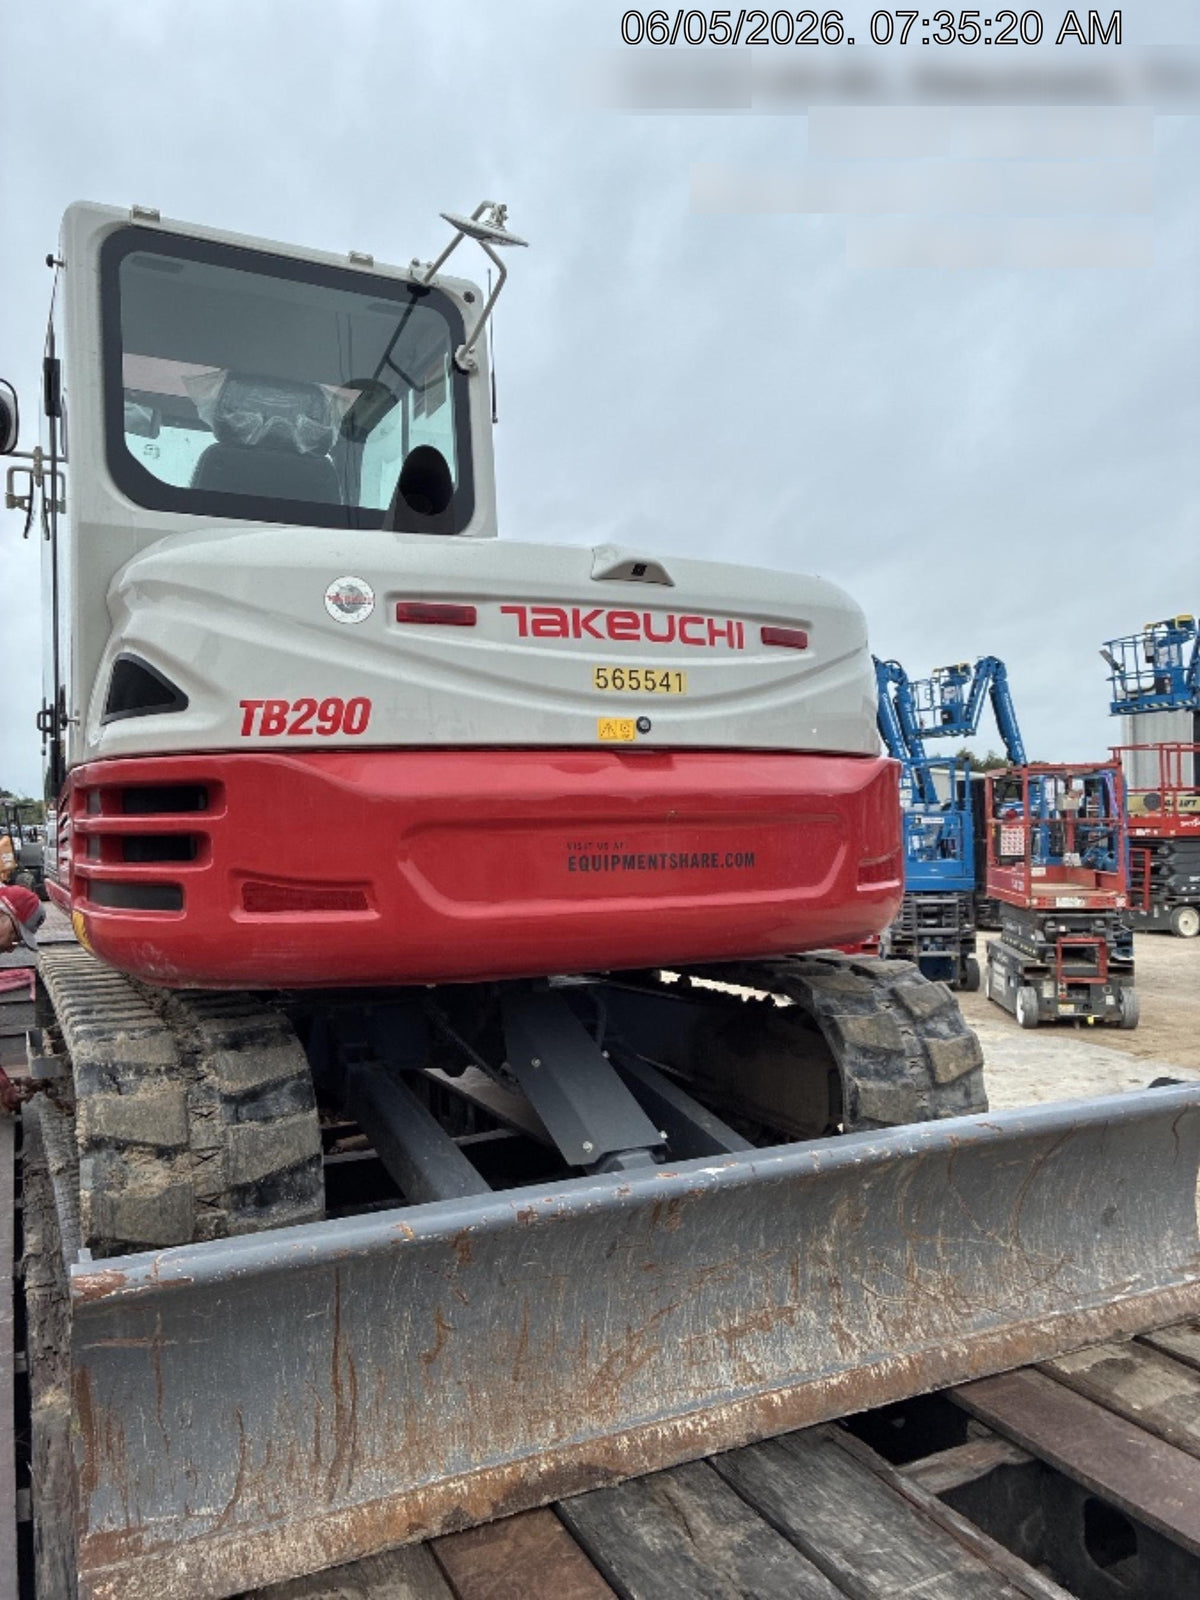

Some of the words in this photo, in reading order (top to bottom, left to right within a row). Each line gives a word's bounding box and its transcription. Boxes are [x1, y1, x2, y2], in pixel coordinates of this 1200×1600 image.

[595, 667, 682, 692] 565541
[239, 696, 372, 736] TB290
[568, 852, 755, 872] EQUIPMENTSHARE.COM
